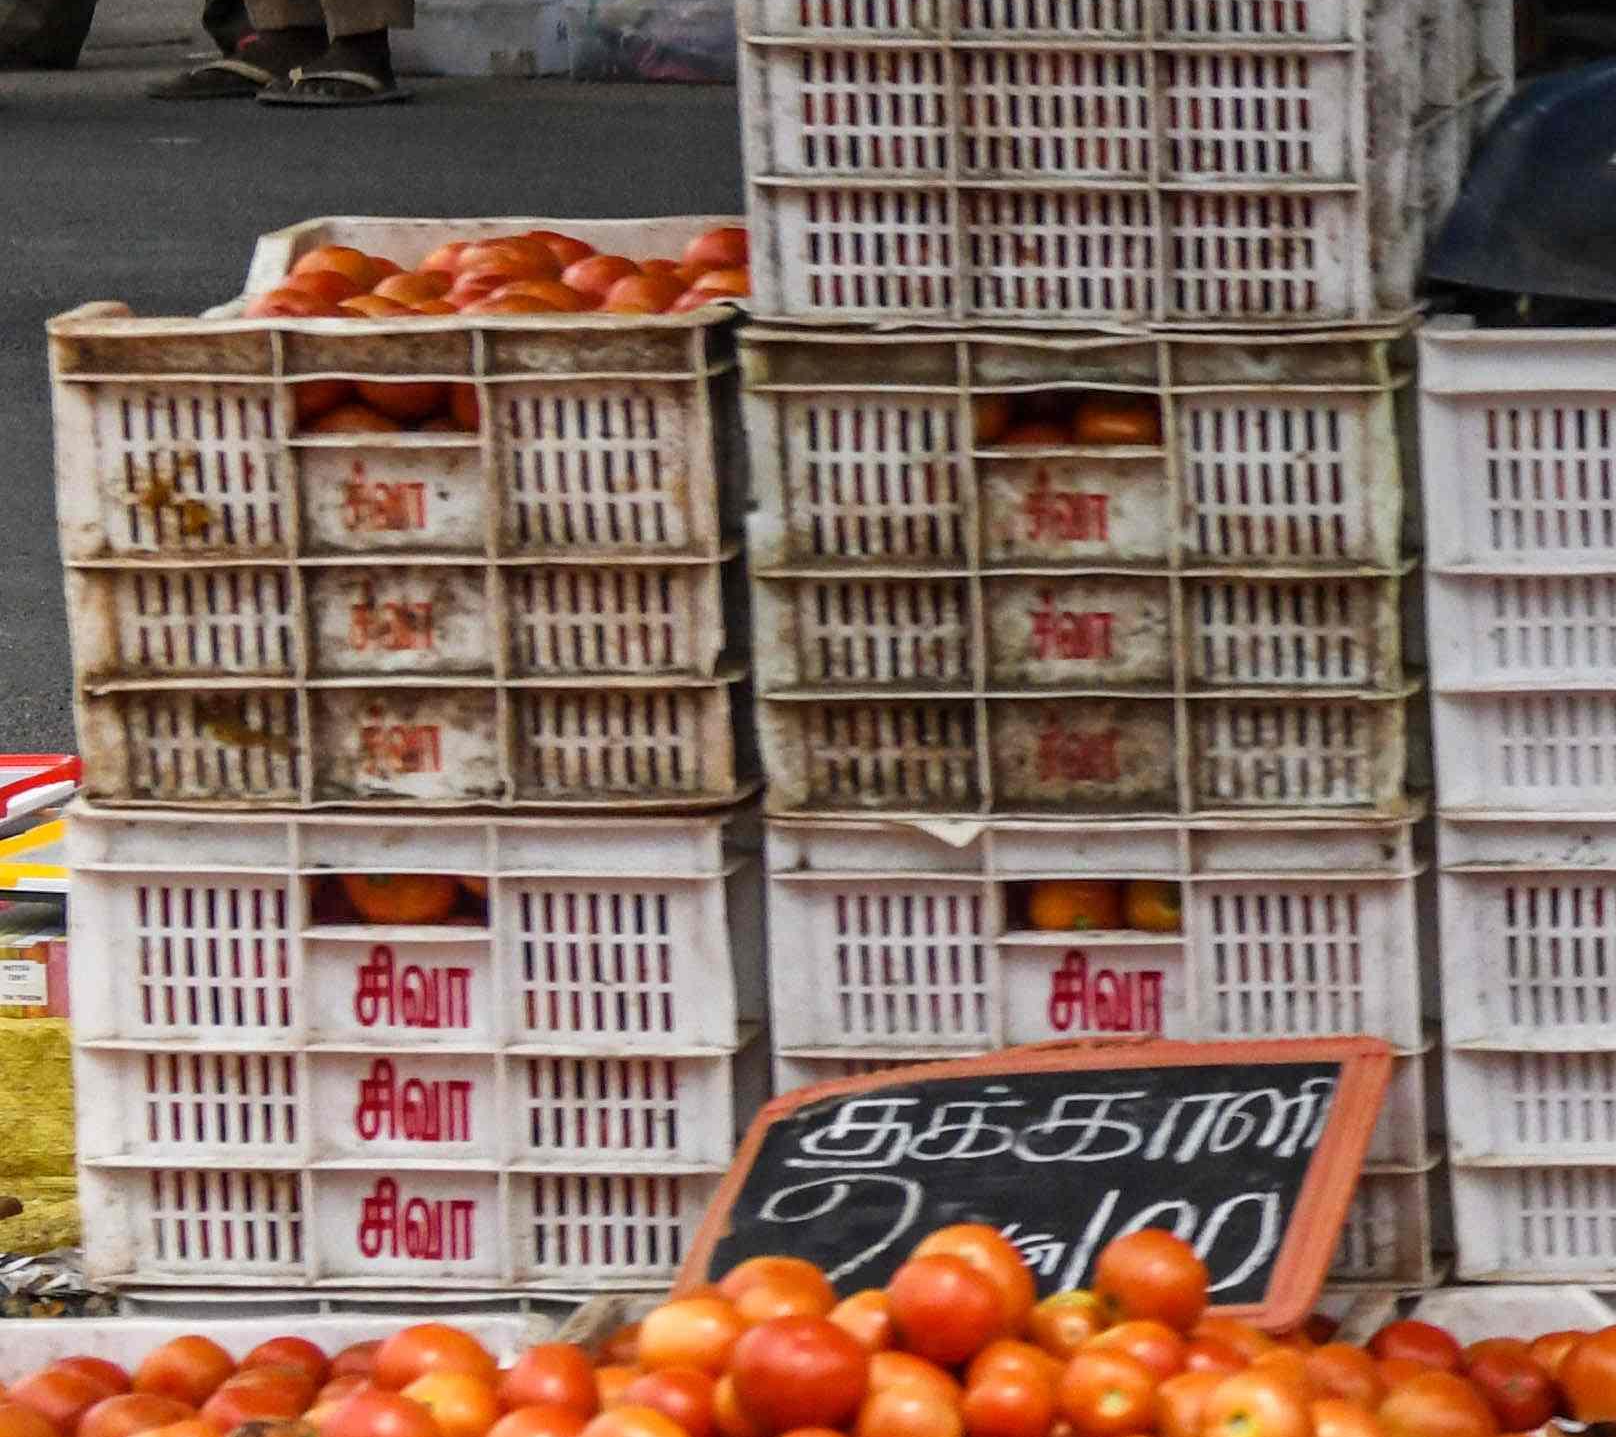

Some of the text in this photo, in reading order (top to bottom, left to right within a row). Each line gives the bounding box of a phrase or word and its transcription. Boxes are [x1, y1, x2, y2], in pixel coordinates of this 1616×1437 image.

[355, 944, 473, 1029] சிவா
[1048, 948, 1166, 1036] சிவா
[355, 1058, 475, 1143] சிவா
[784, 1074, 1338, 1167] தக்காளி
[357, 1177, 478, 1261] சிவா
